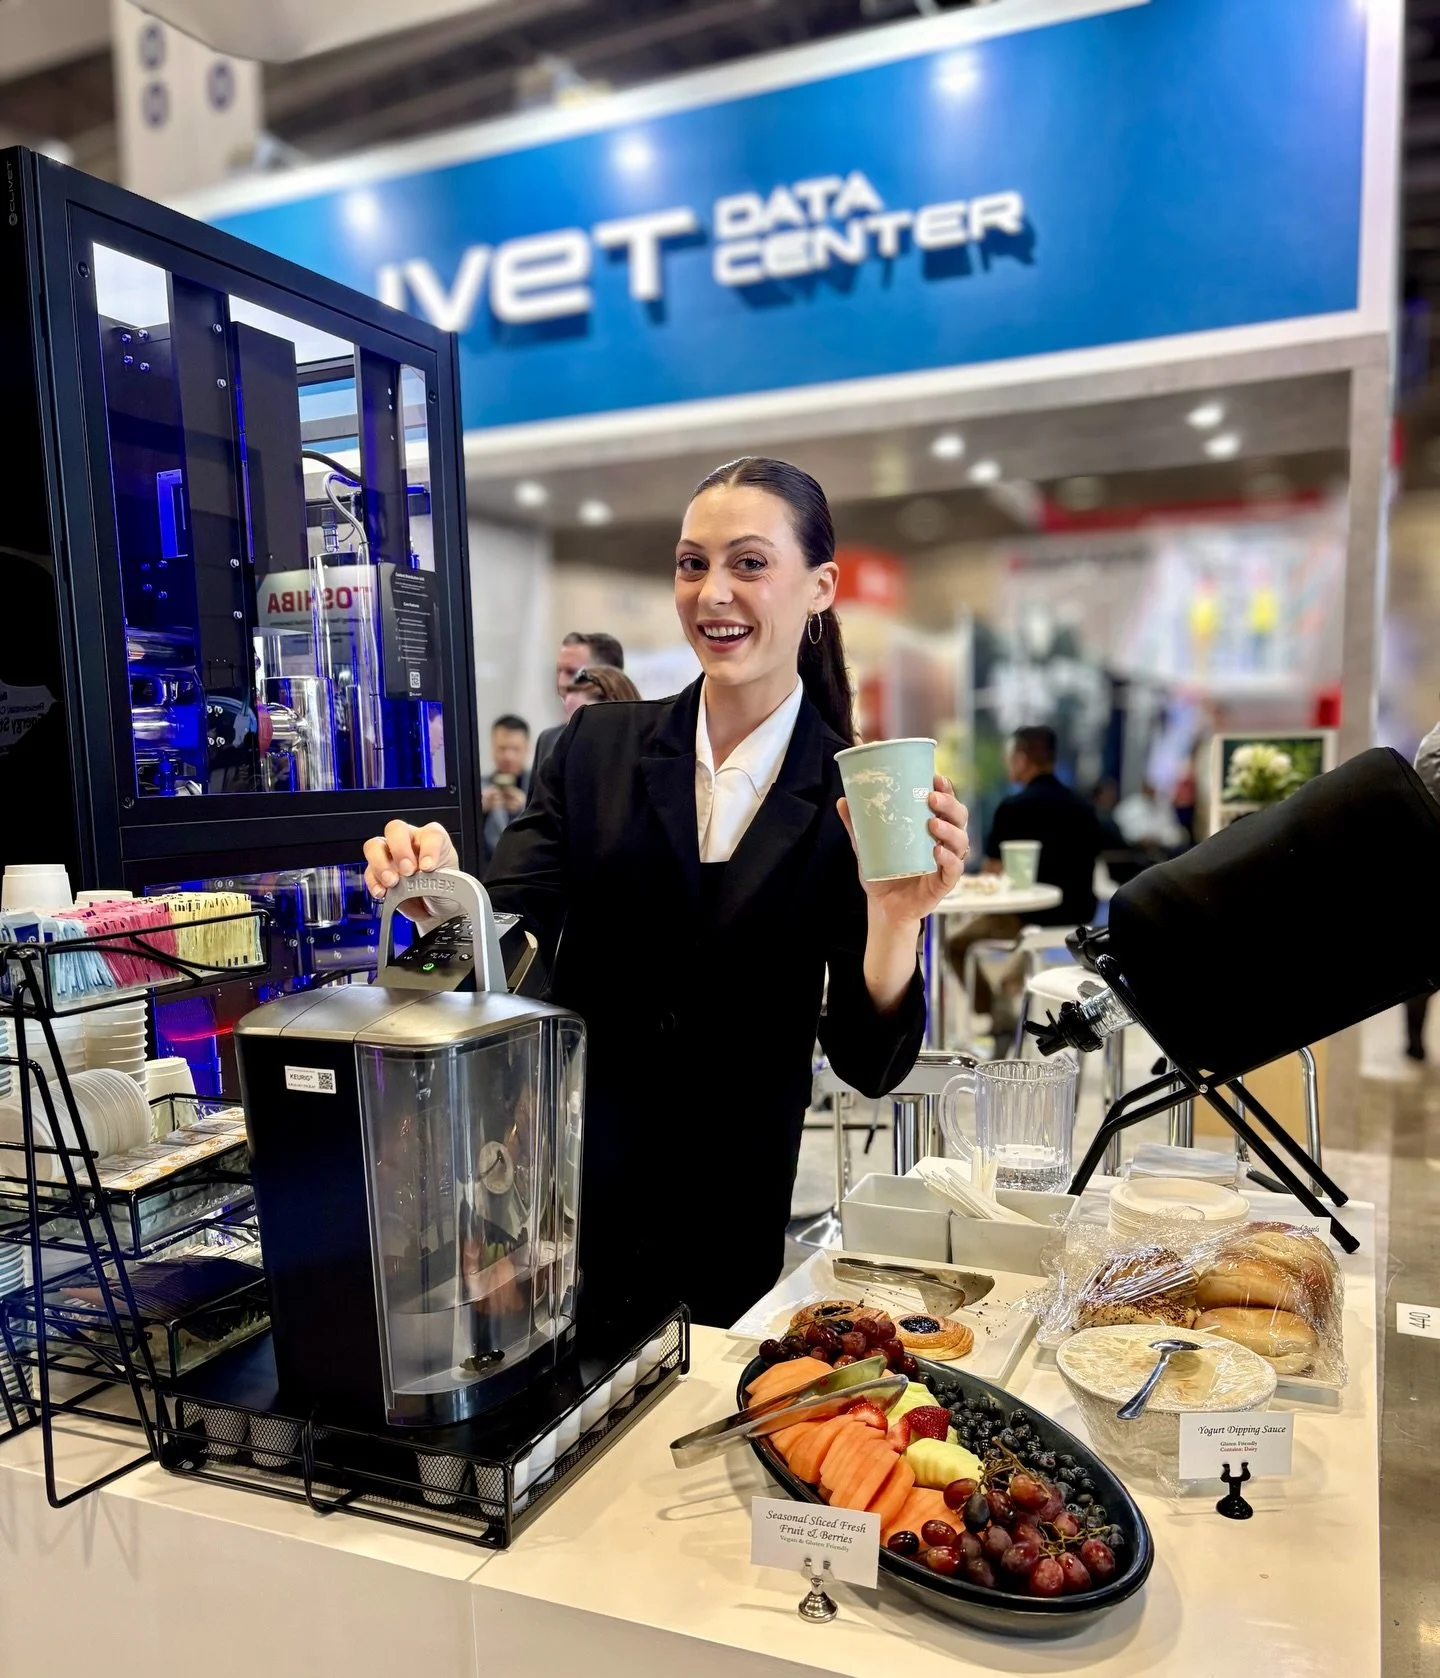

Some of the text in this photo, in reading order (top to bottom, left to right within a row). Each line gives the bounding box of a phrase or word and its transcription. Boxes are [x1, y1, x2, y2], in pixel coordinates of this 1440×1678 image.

[712, 170, 883, 240] DATA
[712, 191, 1024, 287] CENTER
[1409, 1311, 1431, 1329] 440
[1198, 1425, 1286, 1437] Yogurt Dipping Sauce
[766, 1510, 867, 1534] Seasonal Sliced Fresh
[779, 1524, 805, 1536] Fruit
[820, 1530, 854, 1544] Berries
[780, 1535, 798, 1544] Vegan
[805, 1539, 825, 1548] Gluten
[826, 1542, 850, 1553] Friendly
